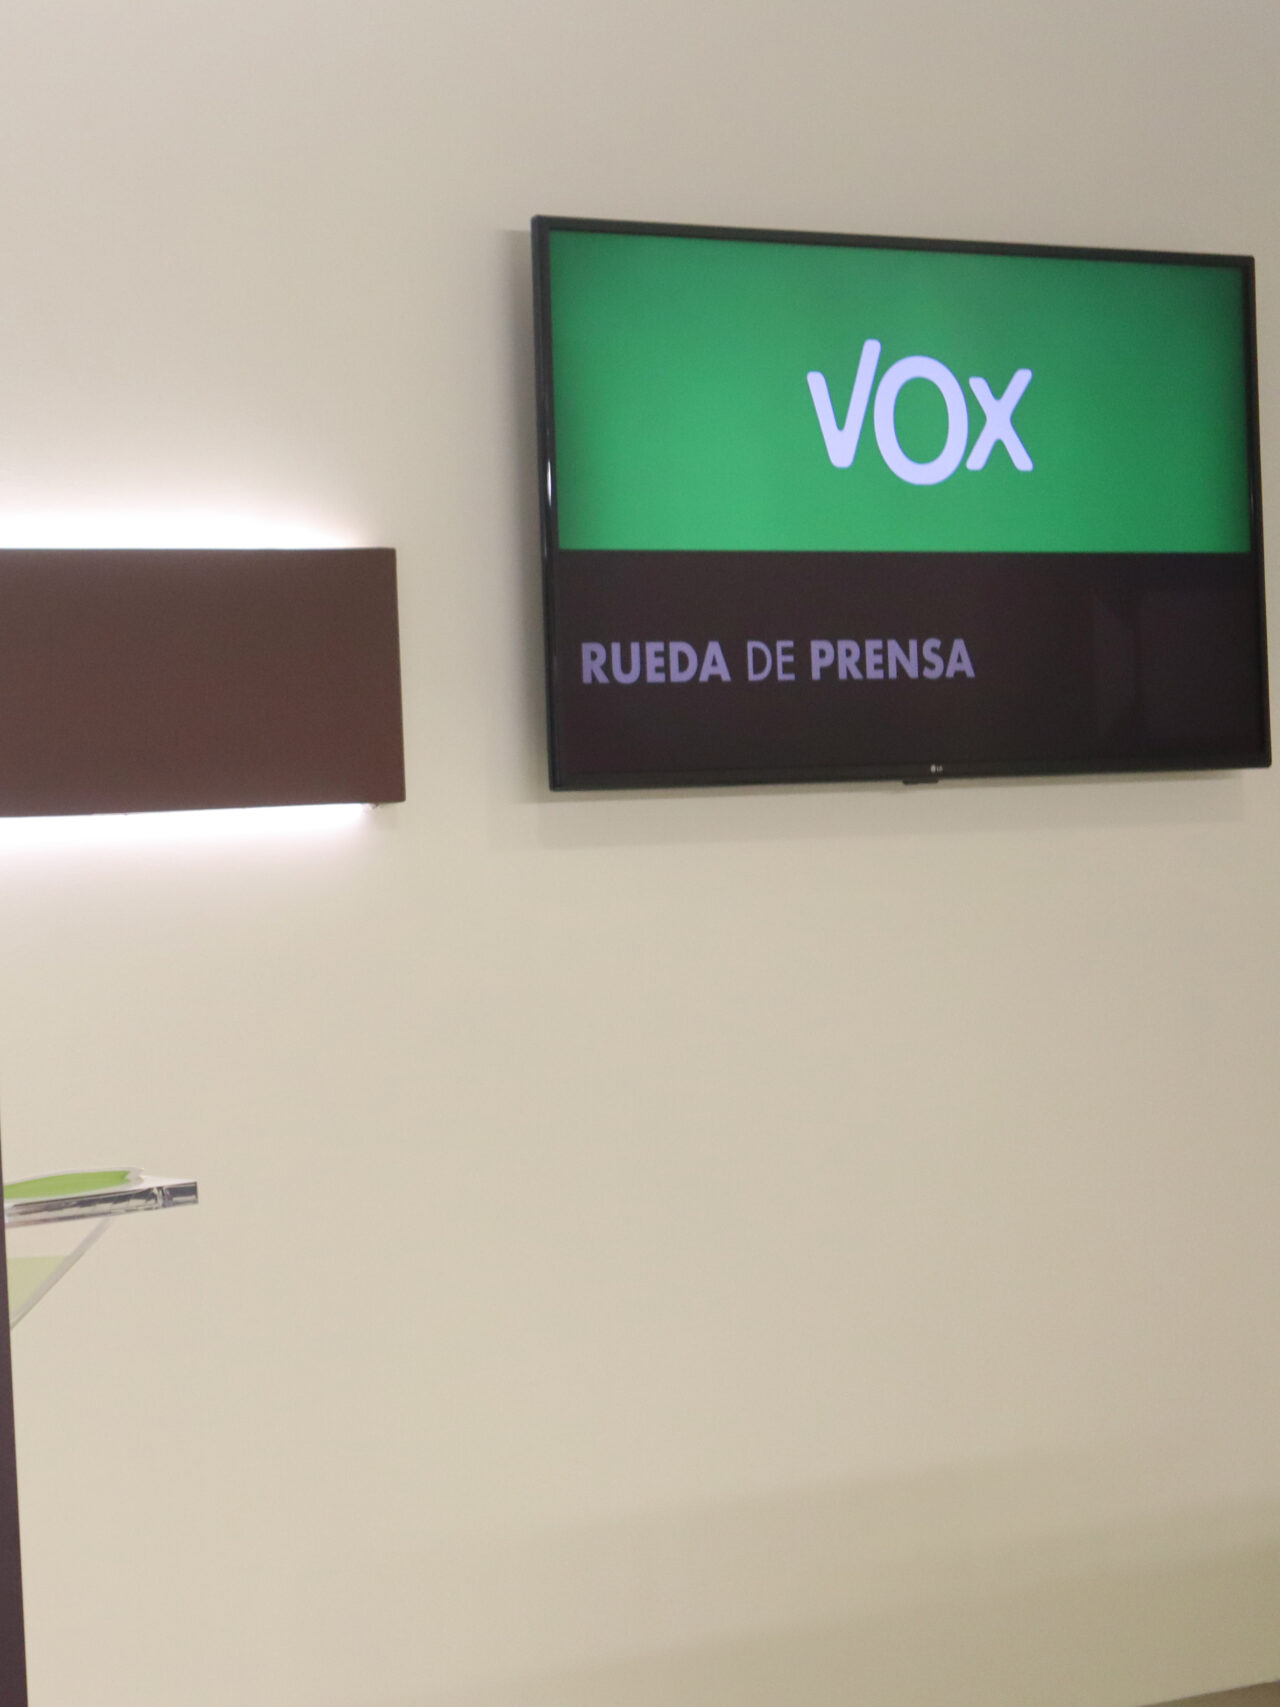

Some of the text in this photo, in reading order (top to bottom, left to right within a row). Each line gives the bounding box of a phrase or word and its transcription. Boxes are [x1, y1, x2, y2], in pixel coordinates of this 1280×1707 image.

[806, 338, 1034, 486] VOX
[581, 637, 976, 685] RUEDA DE PRENSA
